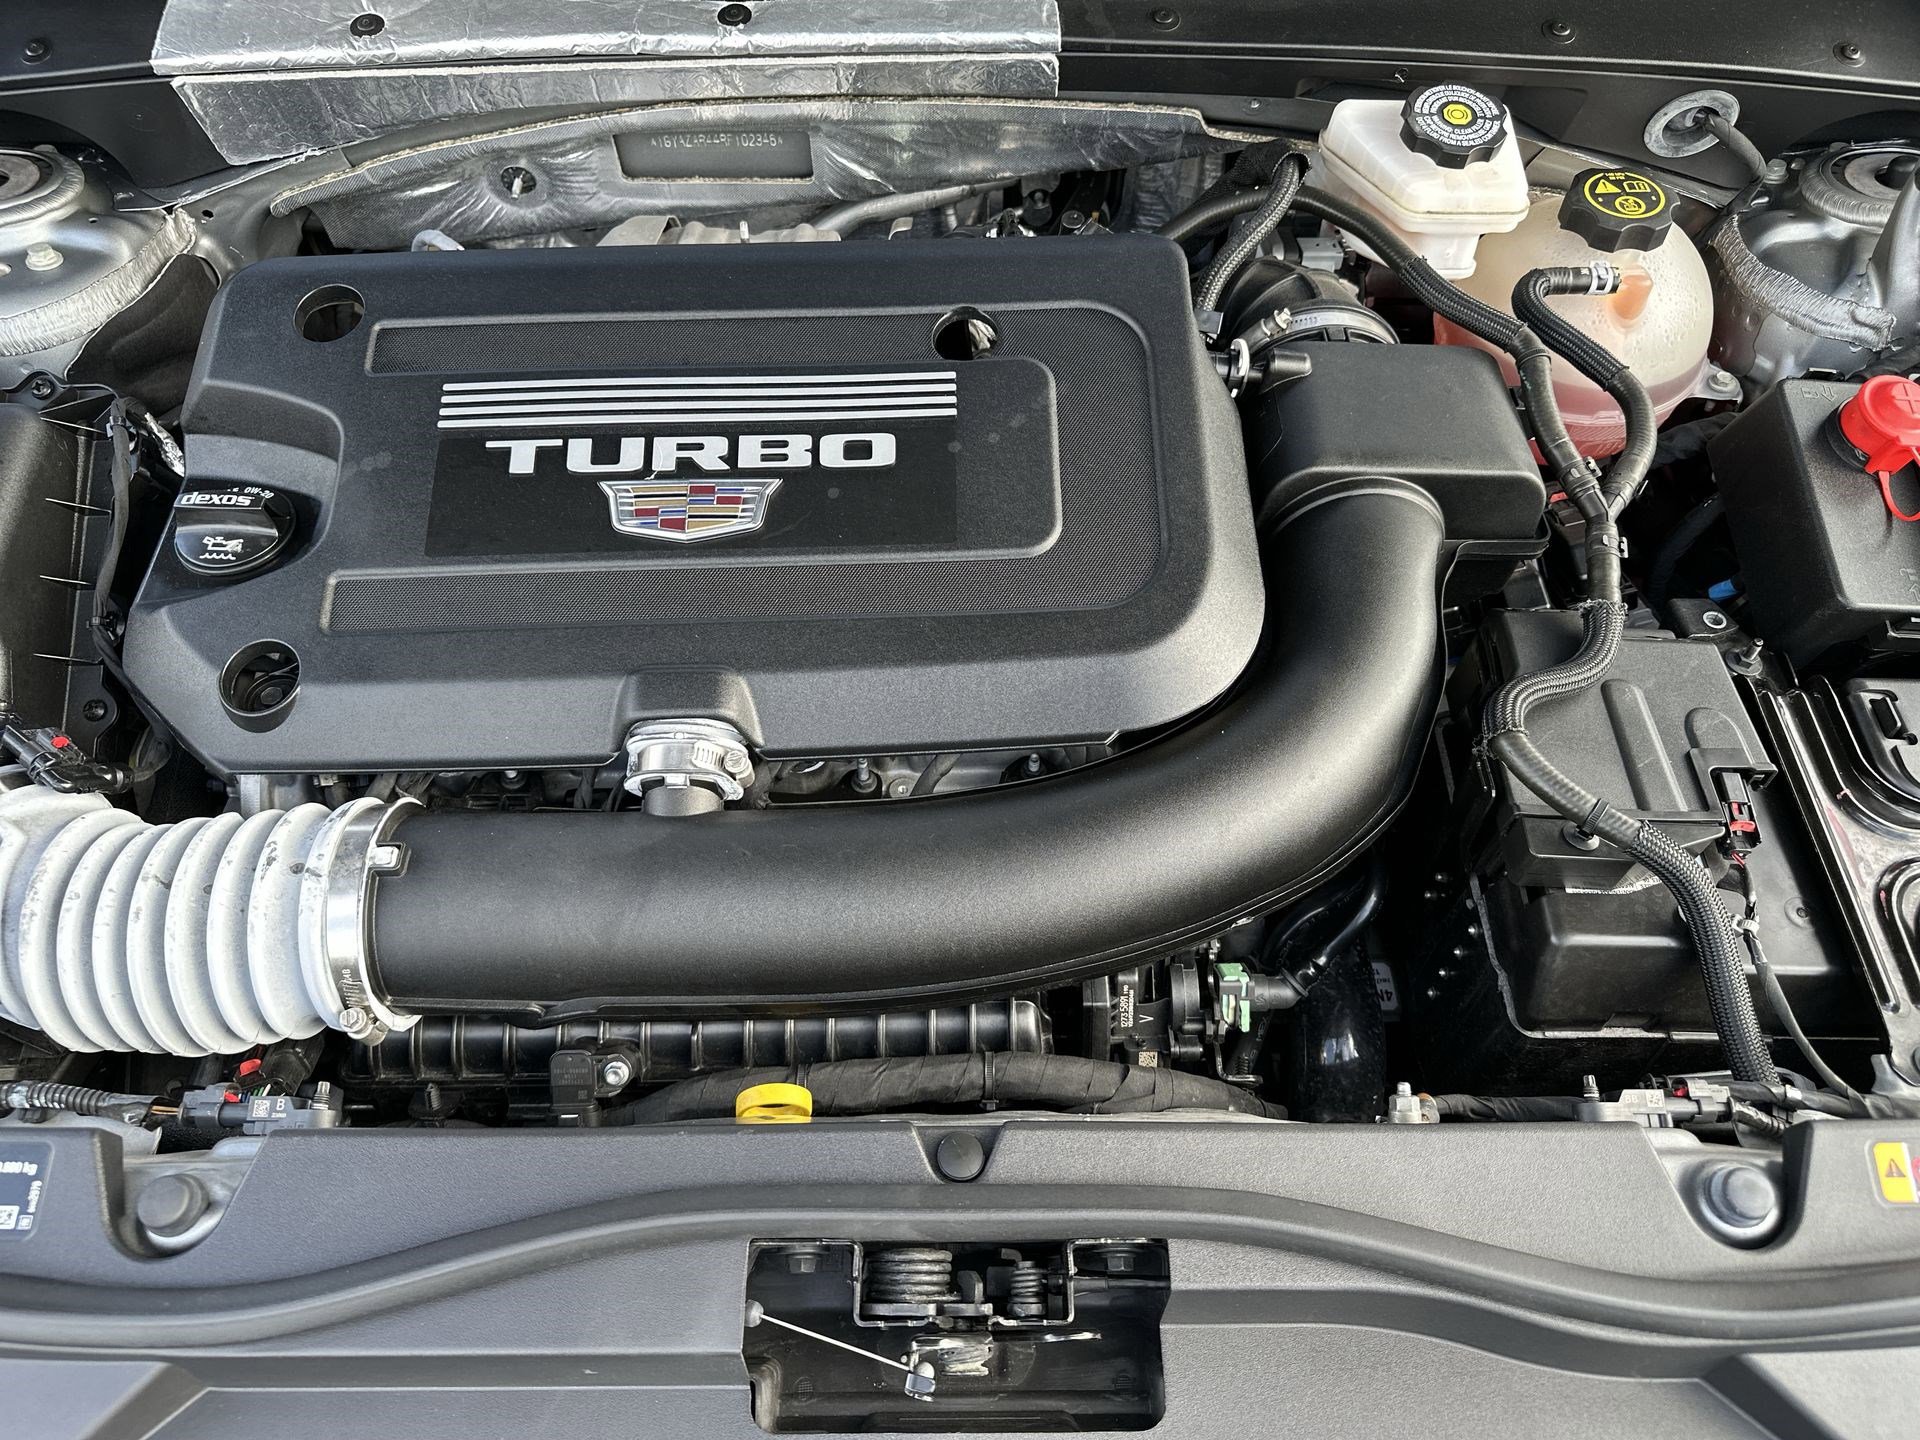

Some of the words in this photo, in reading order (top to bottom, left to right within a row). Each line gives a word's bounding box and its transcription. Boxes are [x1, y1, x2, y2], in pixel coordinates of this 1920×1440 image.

[485, 432, 897, 474] TURBO
[244, 487, 274, 498] 0W-20
[276, 1099, 286, 1110] B
